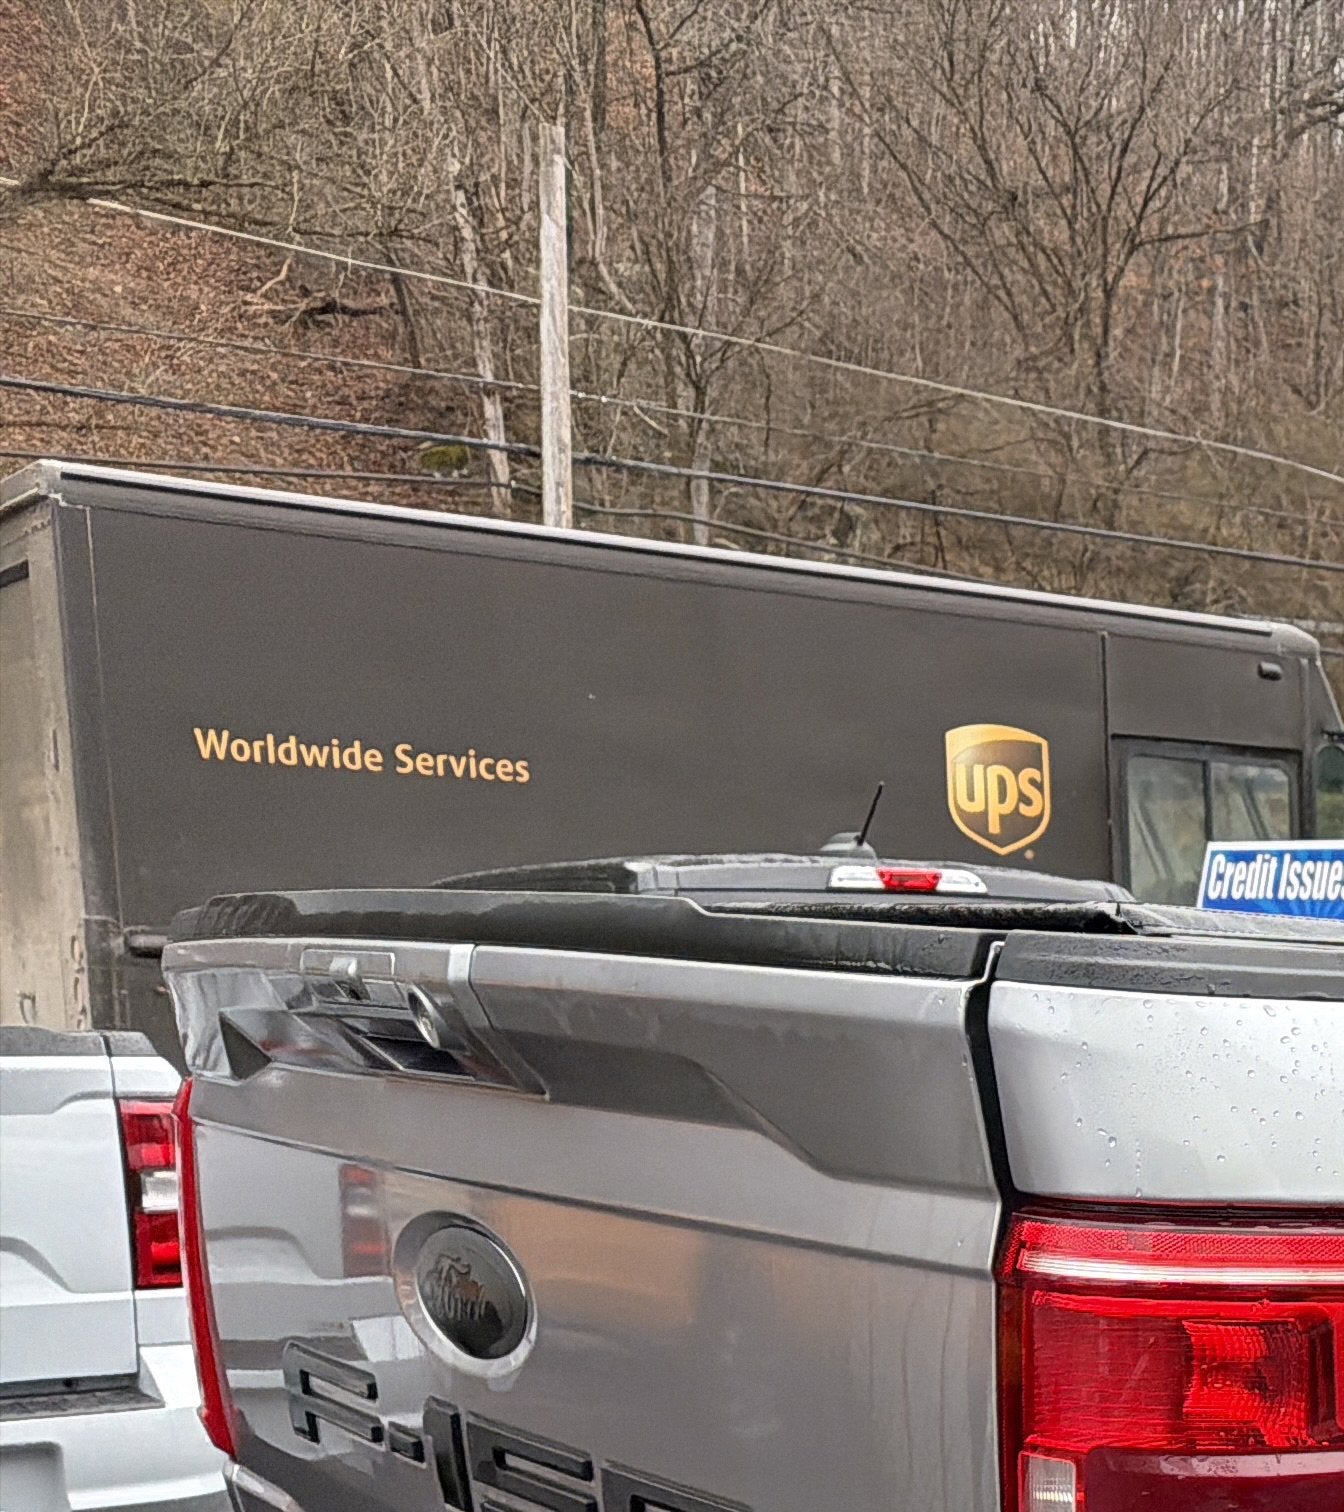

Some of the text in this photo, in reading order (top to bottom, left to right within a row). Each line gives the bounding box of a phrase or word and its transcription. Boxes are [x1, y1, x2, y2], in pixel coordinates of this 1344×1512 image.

[194, 728, 531, 783] Worldwide Services
[955, 762, 1044, 835] ups
[1208, 852, 1279, 901] Credit
